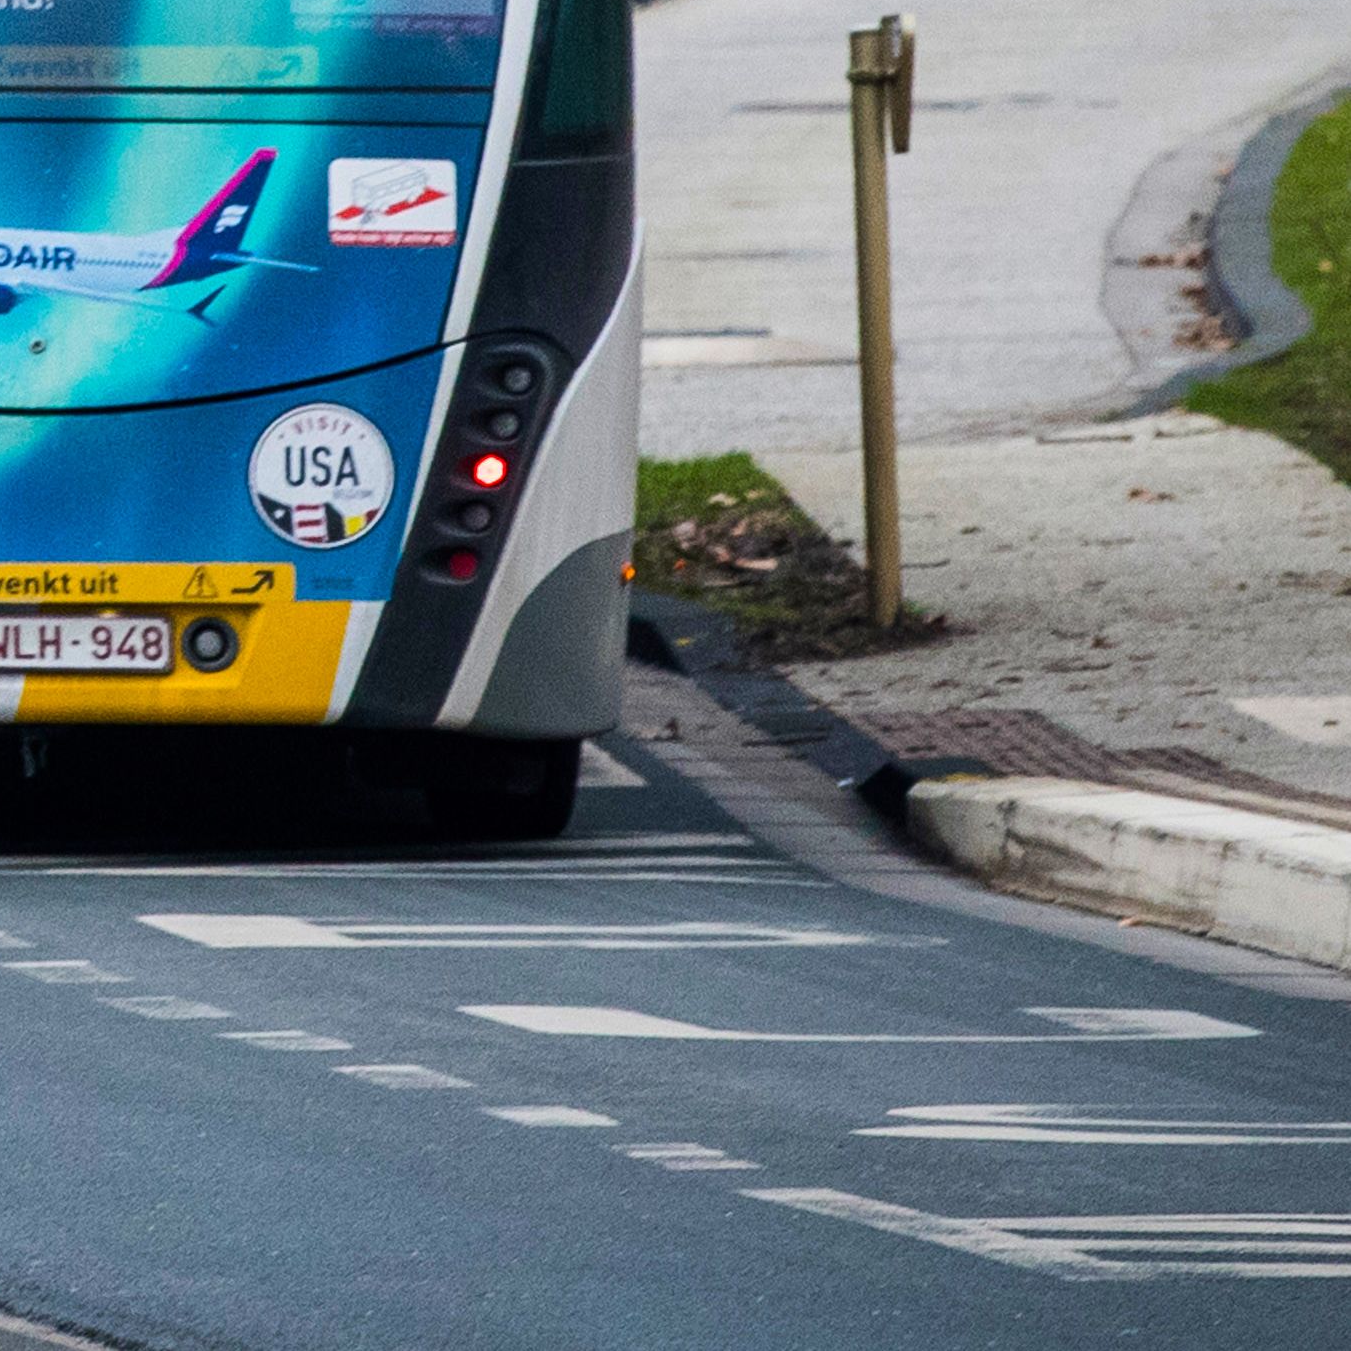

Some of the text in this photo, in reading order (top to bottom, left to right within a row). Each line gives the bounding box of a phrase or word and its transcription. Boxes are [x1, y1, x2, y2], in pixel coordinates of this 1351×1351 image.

[292, 414, 353, 436] VISIT
[284, 445, 361, 488] USA
[79, 571, 119, 595] uit
